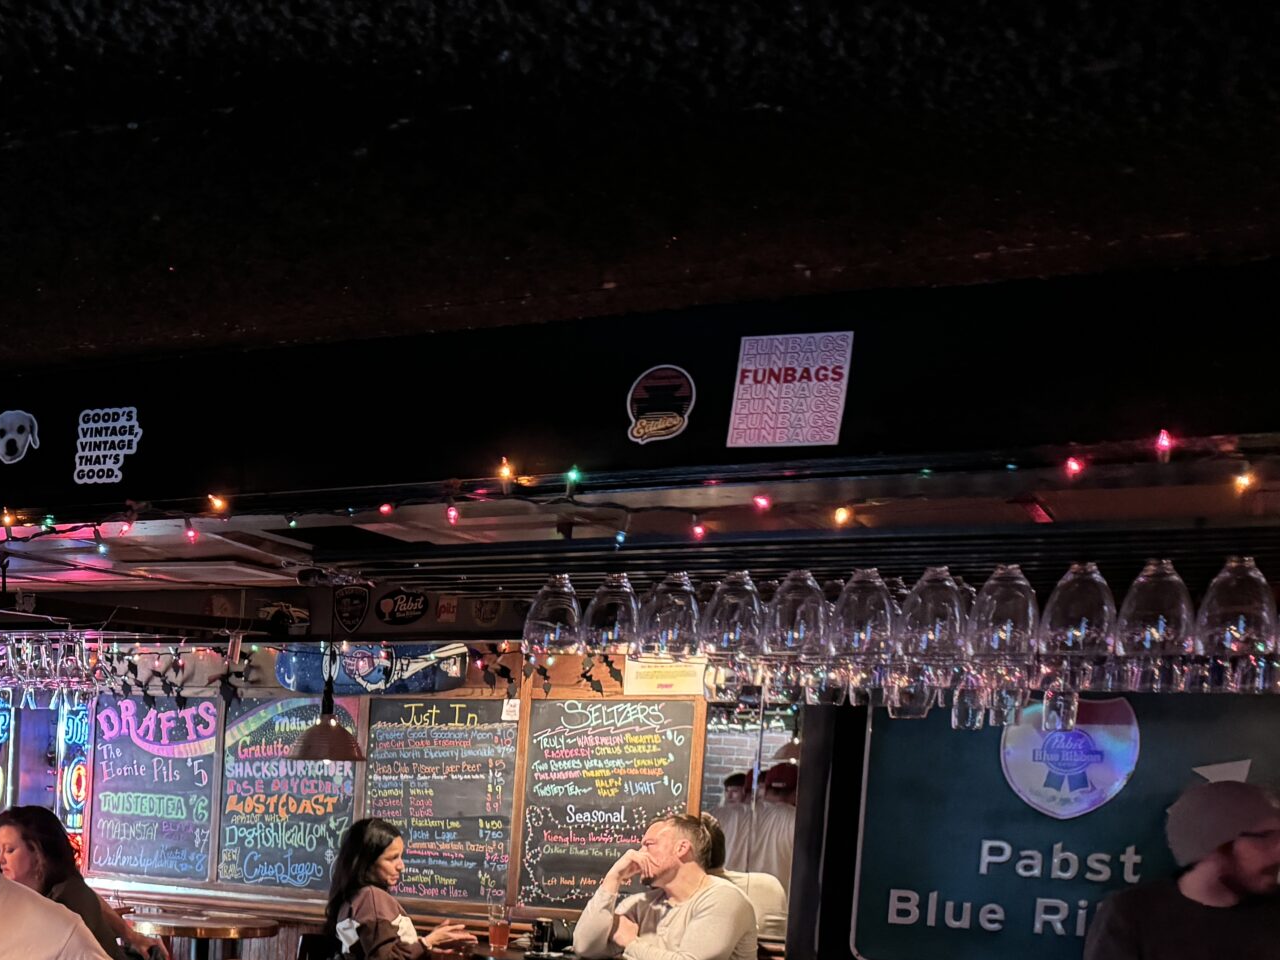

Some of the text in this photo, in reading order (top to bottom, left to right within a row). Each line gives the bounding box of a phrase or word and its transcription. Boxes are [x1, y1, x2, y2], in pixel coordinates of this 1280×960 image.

[743, 335, 849, 354] FUNBAGS
[741, 351, 848, 368] FUNBAGS
[739, 366, 844, 385] FUNBAGS
[737, 381, 842, 399] FUNBAGS
[735, 396, 840, 414] FUNBAGS
[82, 411, 133, 424] GOOD'S
[733, 411, 838, 429] FUNBAGS
[81, 425, 139, 439] VINTAGE,
[730, 427, 836, 444] FUNBAGS
[80, 439, 133, 452] VINTAGE
[78, 454, 120, 466] THAT'S
[77, 468, 119, 480] GOOD.
[394, 594, 424, 612] Pabst
[97, 699, 217, 744] DRAFTS
[400, 703, 478, 727] Just In
[561, 700, 665, 729] SELTZERS
[375, 730, 405, 741] Greater
[407, 729, 428, 739] Good
[471, 730, 493, 740] Moon
[537, 735, 566, 750] TRULY
[576, 735, 624, 747] WATERMELON
[1051, 733, 1086, 750] Pabst
[97, 743, 122, 760] The
[375, 741, 390, 749] Love
[544, 748, 592, 759] RASPBERRY
[594, 746, 622, 755] CITRUS
[399, 750, 421, 759] North
[633, 758, 653, 768] LEMON
[100, 760, 146, 782] Homie
[152, 757, 180, 783] Pils
[225, 760, 354, 779] SHACKSBURY CIDER
[373, 763, 392, 774] Utica
[393, 762, 409, 773] Club
[461, 762, 482, 773] Beer
[409, 788, 434, 796] White
[535, 782, 584, 797] TWISTED TEA
[629, 780, 656, 797] LIGHT
[100, 791, 155, 817] TWISTED
[225, 793, 339, 818] LOST COAST
[231, 813, 261, 825] APRICOT
[566, 804, 627, 823] Seasonal
[97, 818, 158, 841] MAINSTAY
[409, 828, 430, 841] Yacht
[435, 830, 458, 842] Lager
[543, 830, 586, 845] Yuengling
[543, 845, 567, 855] Oskar
[244, 851, 284, 883] Crisp
[282, 850, 323, 881] Lager
[979, 840, 1142, 884] Pabst
[542, 876, 557, 886] Left
[560, 876, 575, 886] Hand
[419, 883, 439, 896] Shape
[449, 886, 468, 897] Haze
[888, 888, 1094, 937] Blue Ri
